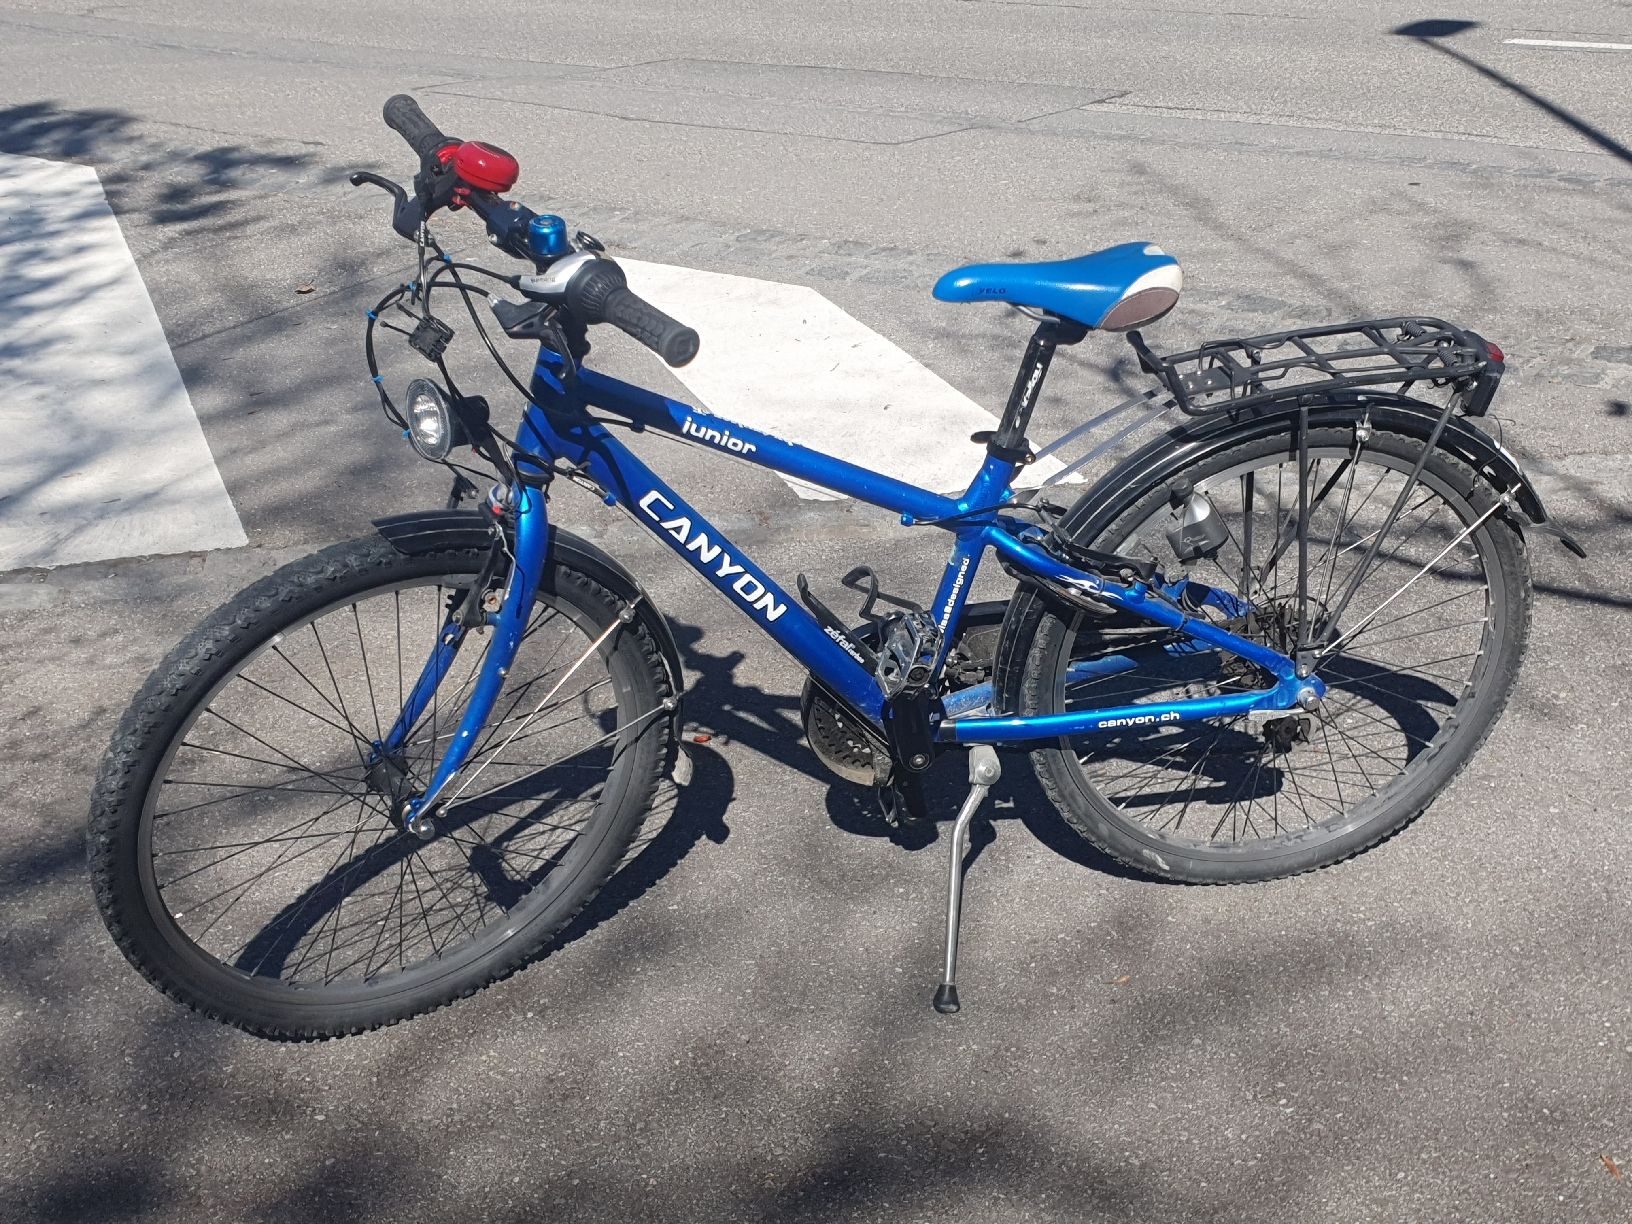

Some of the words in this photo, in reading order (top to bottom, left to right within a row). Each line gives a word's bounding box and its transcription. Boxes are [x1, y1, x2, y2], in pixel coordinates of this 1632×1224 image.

[682, 416, 757, 454] junior
[639, 489, 788, 622] CANYON
[1098, 711, 1180, 728] canyon.ch
